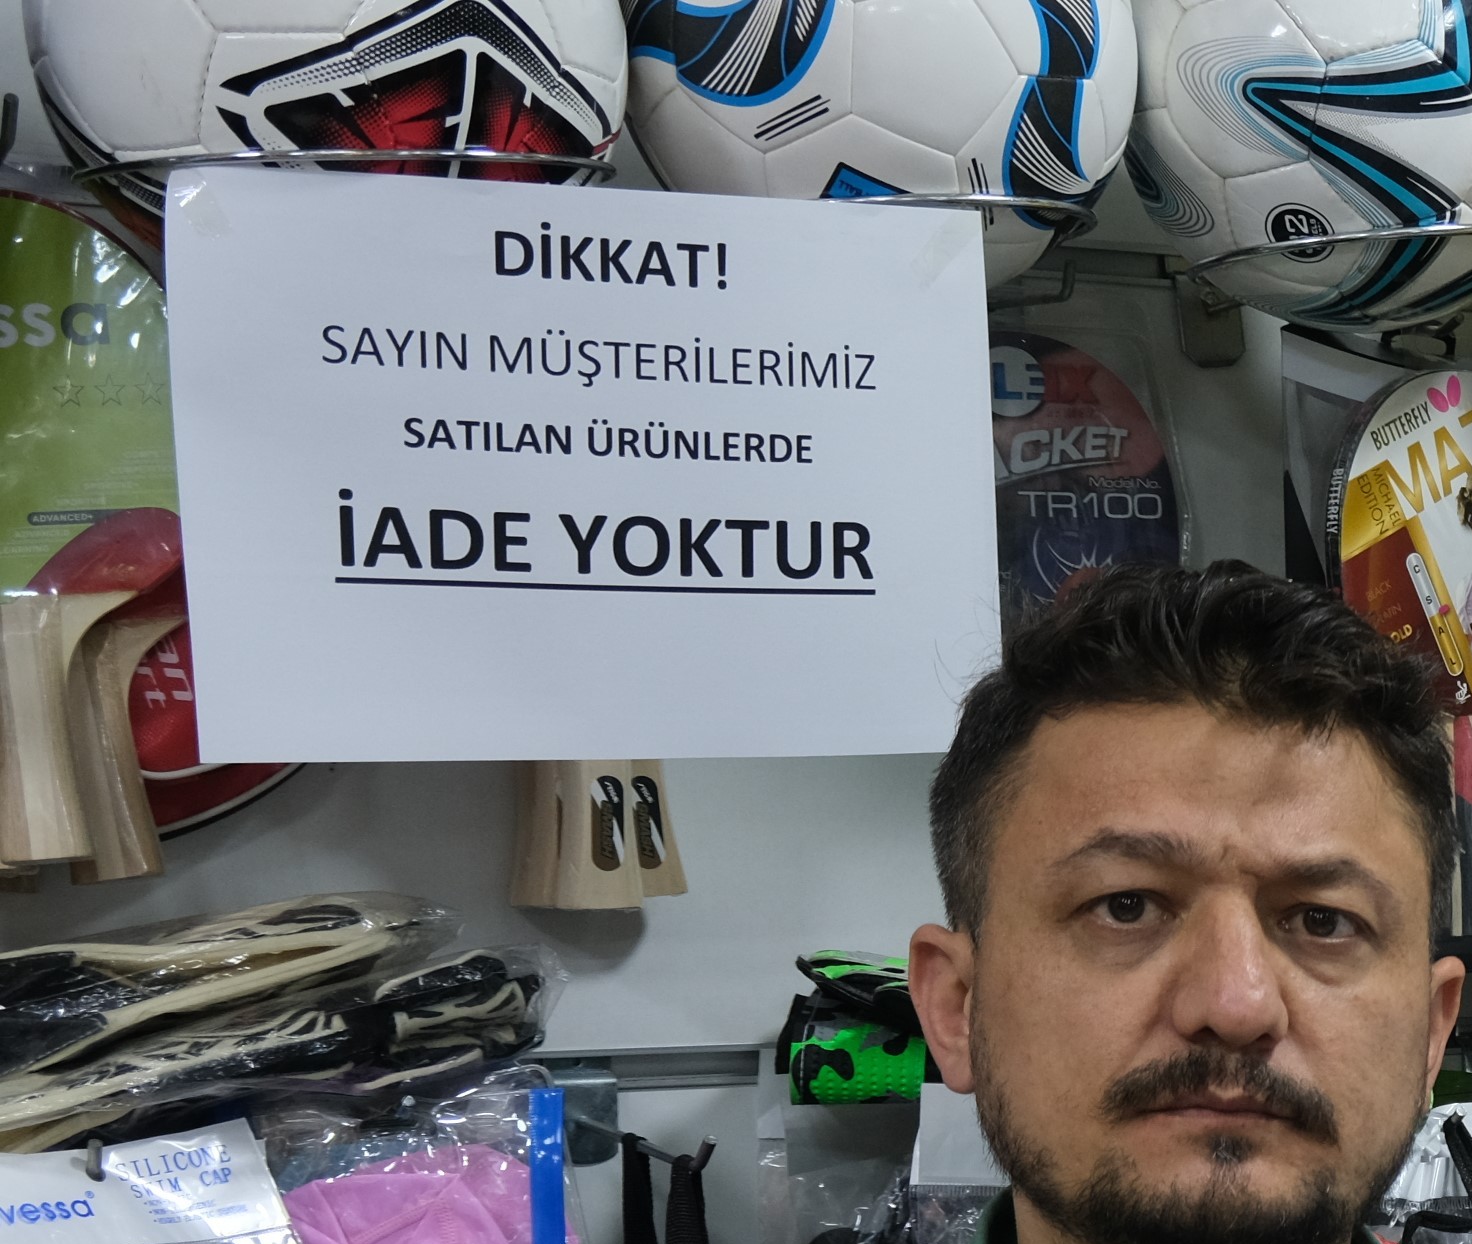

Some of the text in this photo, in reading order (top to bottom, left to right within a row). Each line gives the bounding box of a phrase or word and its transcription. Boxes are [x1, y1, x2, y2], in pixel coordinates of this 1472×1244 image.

[494, 223, 728, 290] DİKKAT!
[321, 325, 877, 391] SAYIN MÜŞTERİLERİMİZ
[403, 416, 813, 464] SATILAN ÜRÜNLERDE
[1370, 401, 1432, 451] BUTTERFLY
[32, 513, 94, 523] ADVANCED+
[1017, 491, 1162, 519] TR100
[1326, 467, 1345, 534] BUTTERFLY
[1357, 475, 1389, 536] EDITION
[1371, 467, 1401, 527] MICHAEL
[338, 489, 874, 580] İADE YOKTUR
[1366, 580, 1393, 601] BLACK
[115, 1144, 232, 1182] SILICONE
[130, 1167, 232, 1199] SWIM CAP
